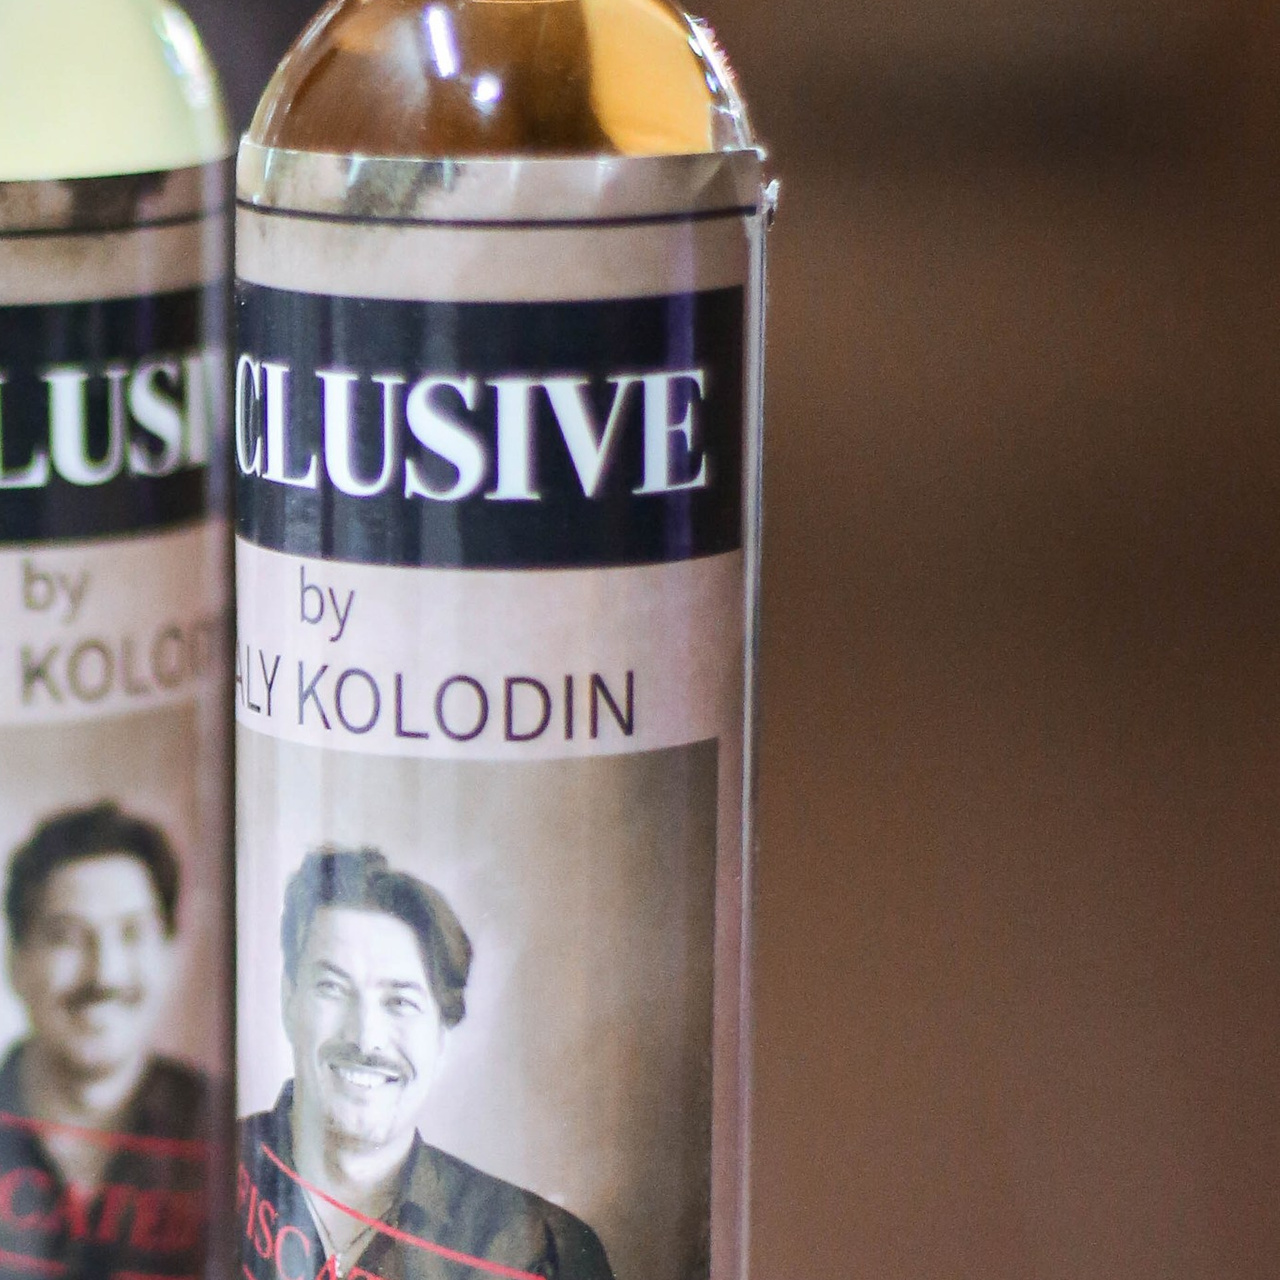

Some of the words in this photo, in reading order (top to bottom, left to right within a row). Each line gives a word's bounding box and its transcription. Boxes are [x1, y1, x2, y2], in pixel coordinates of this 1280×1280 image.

[236, 353, 708, 501] CLUSIVE
[22, 557, 89, 619] by
[299, 565, 355, 642] by
[297, 659, 636, 743] KOLODIN
